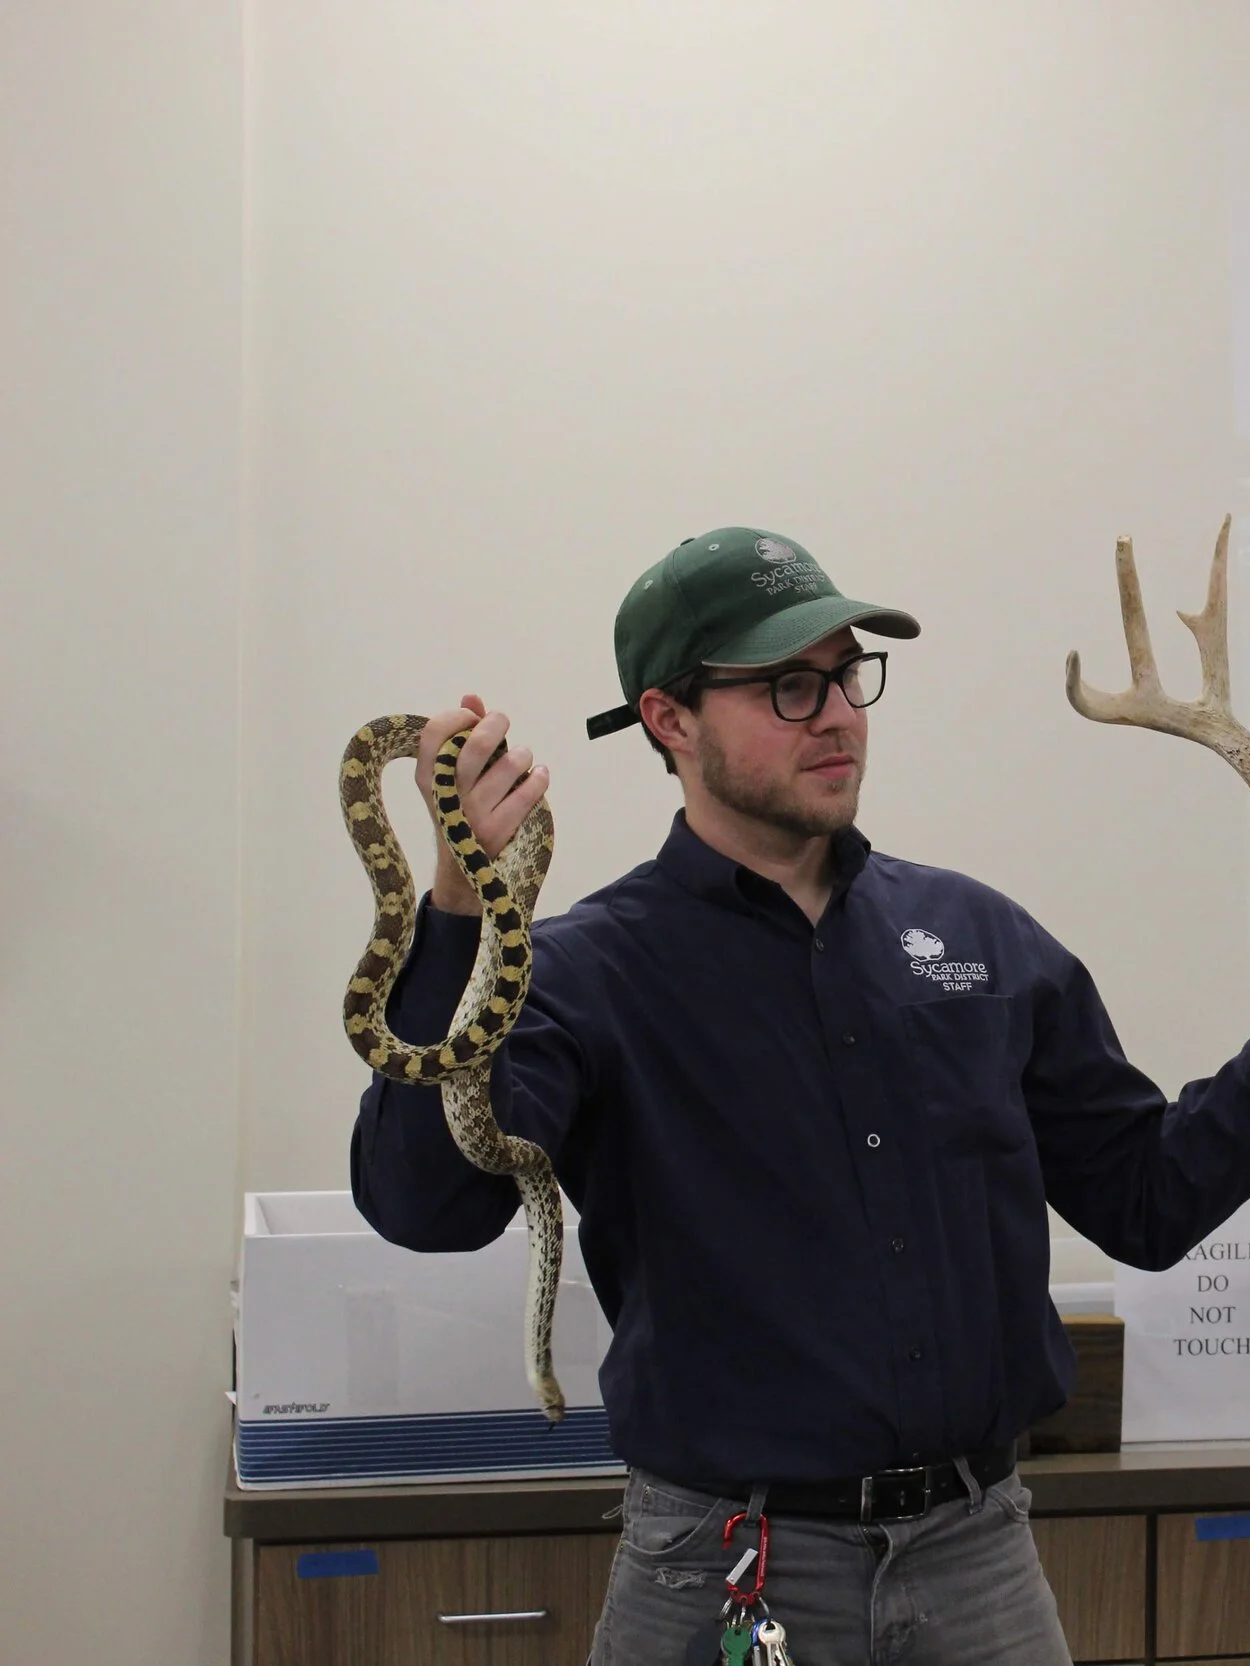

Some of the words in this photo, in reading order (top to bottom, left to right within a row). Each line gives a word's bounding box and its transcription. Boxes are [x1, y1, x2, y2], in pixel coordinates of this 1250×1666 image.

[766, 579, 794, 595] PARK
[910, 961, 987, 977] Sycamore
[931, 973, 953, 981] PARK
[954, 973, 988, 981] DISTRICT
[943, 982, 973, 991] STAFF
[1197, 1274, 1230, 1293] DO
[1189, 1306, 1237, 1324] NOT
[1173, 1337, 1250, 1356] TOUCH
